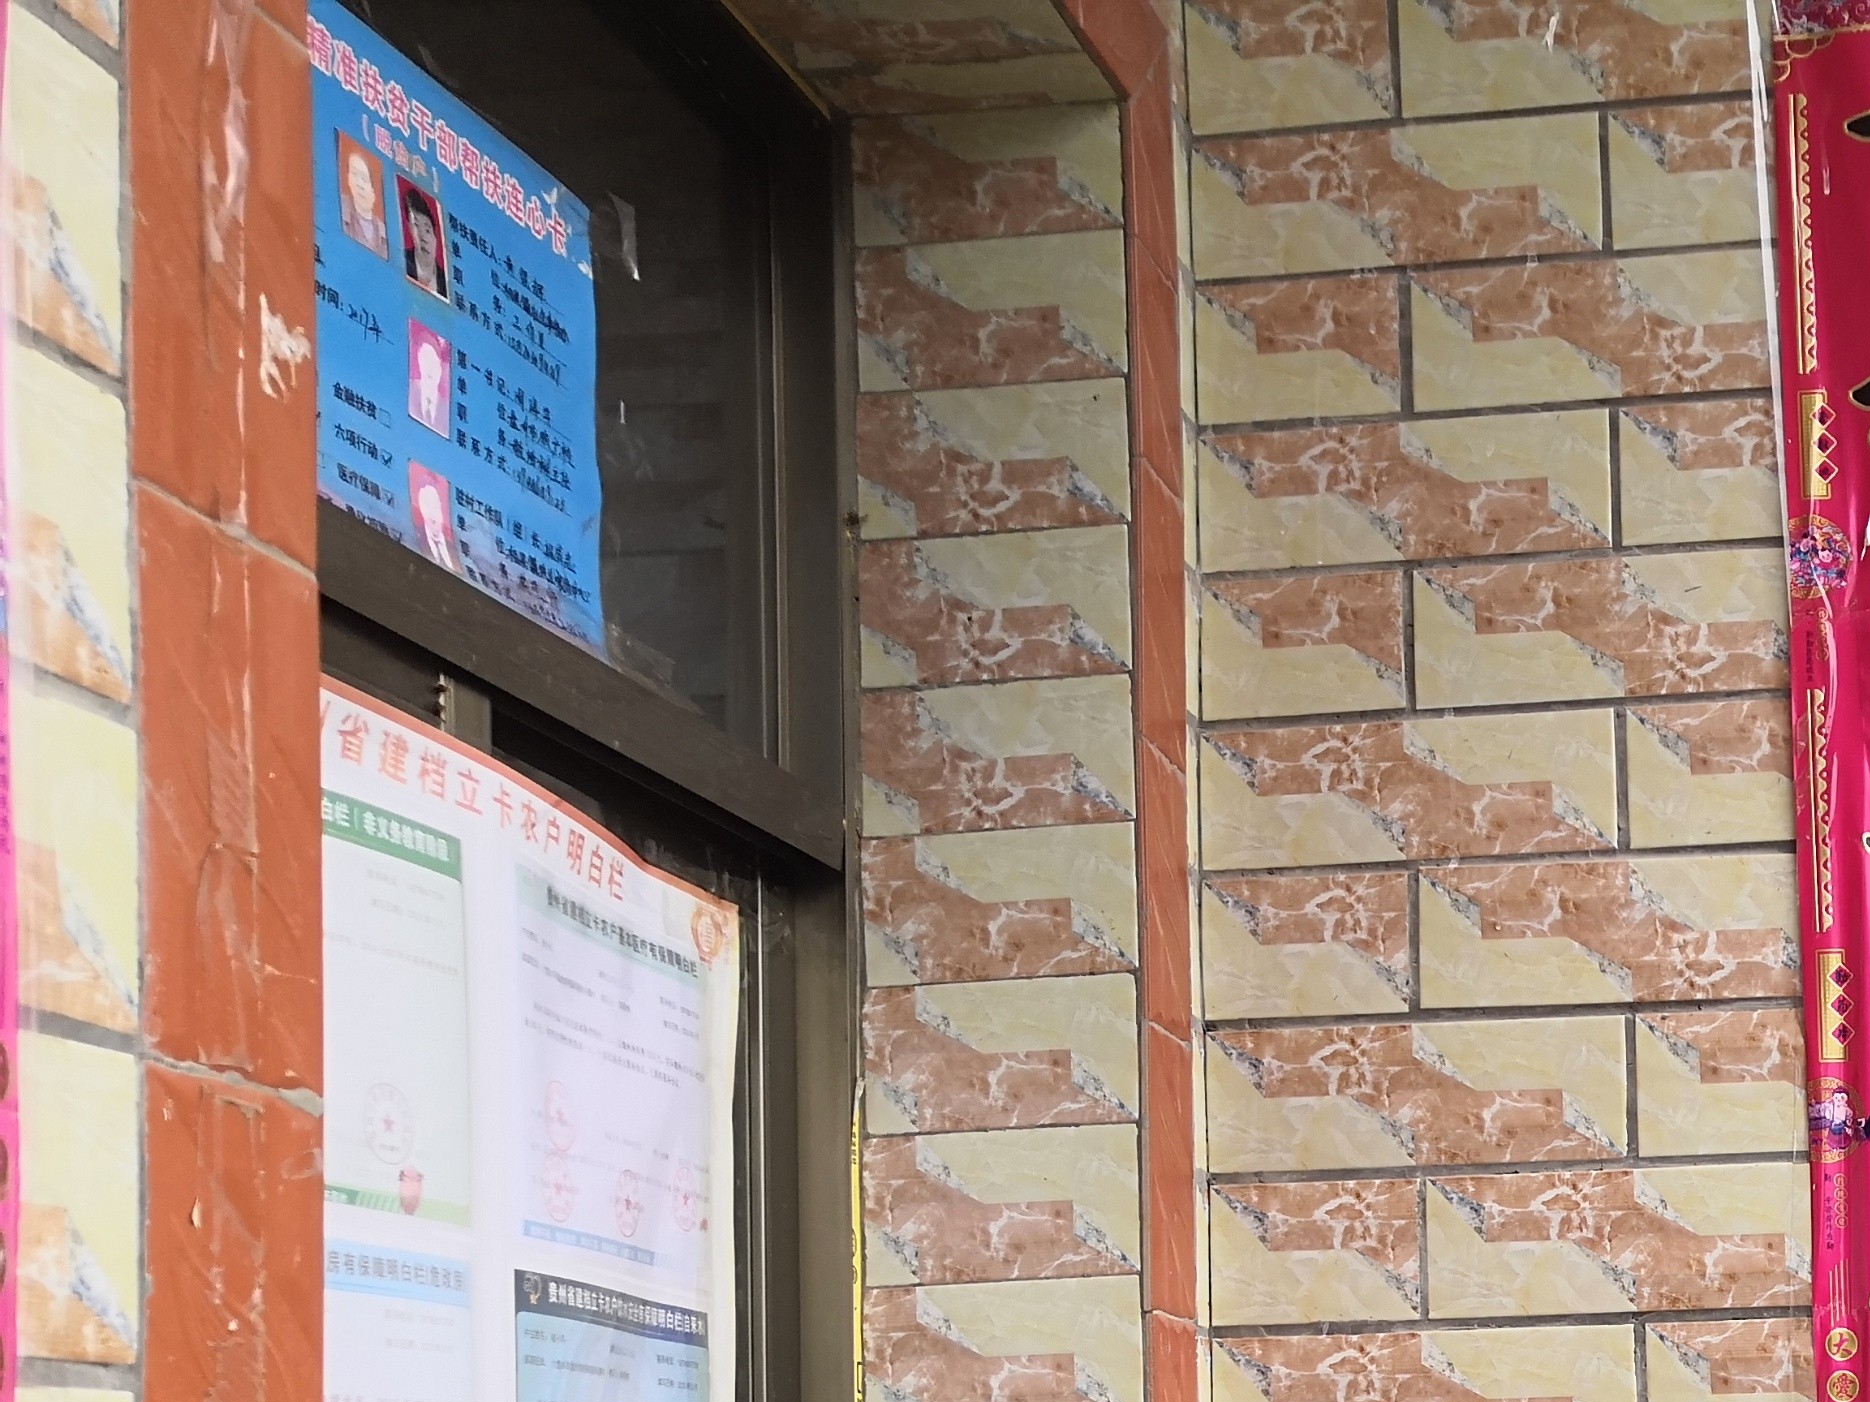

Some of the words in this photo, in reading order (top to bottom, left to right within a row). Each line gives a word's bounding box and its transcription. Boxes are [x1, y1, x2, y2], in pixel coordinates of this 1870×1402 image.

[334, 422, 379, 461] 六项行动
[321, 701, 624, 902] 省建档立卡农户明白栏
